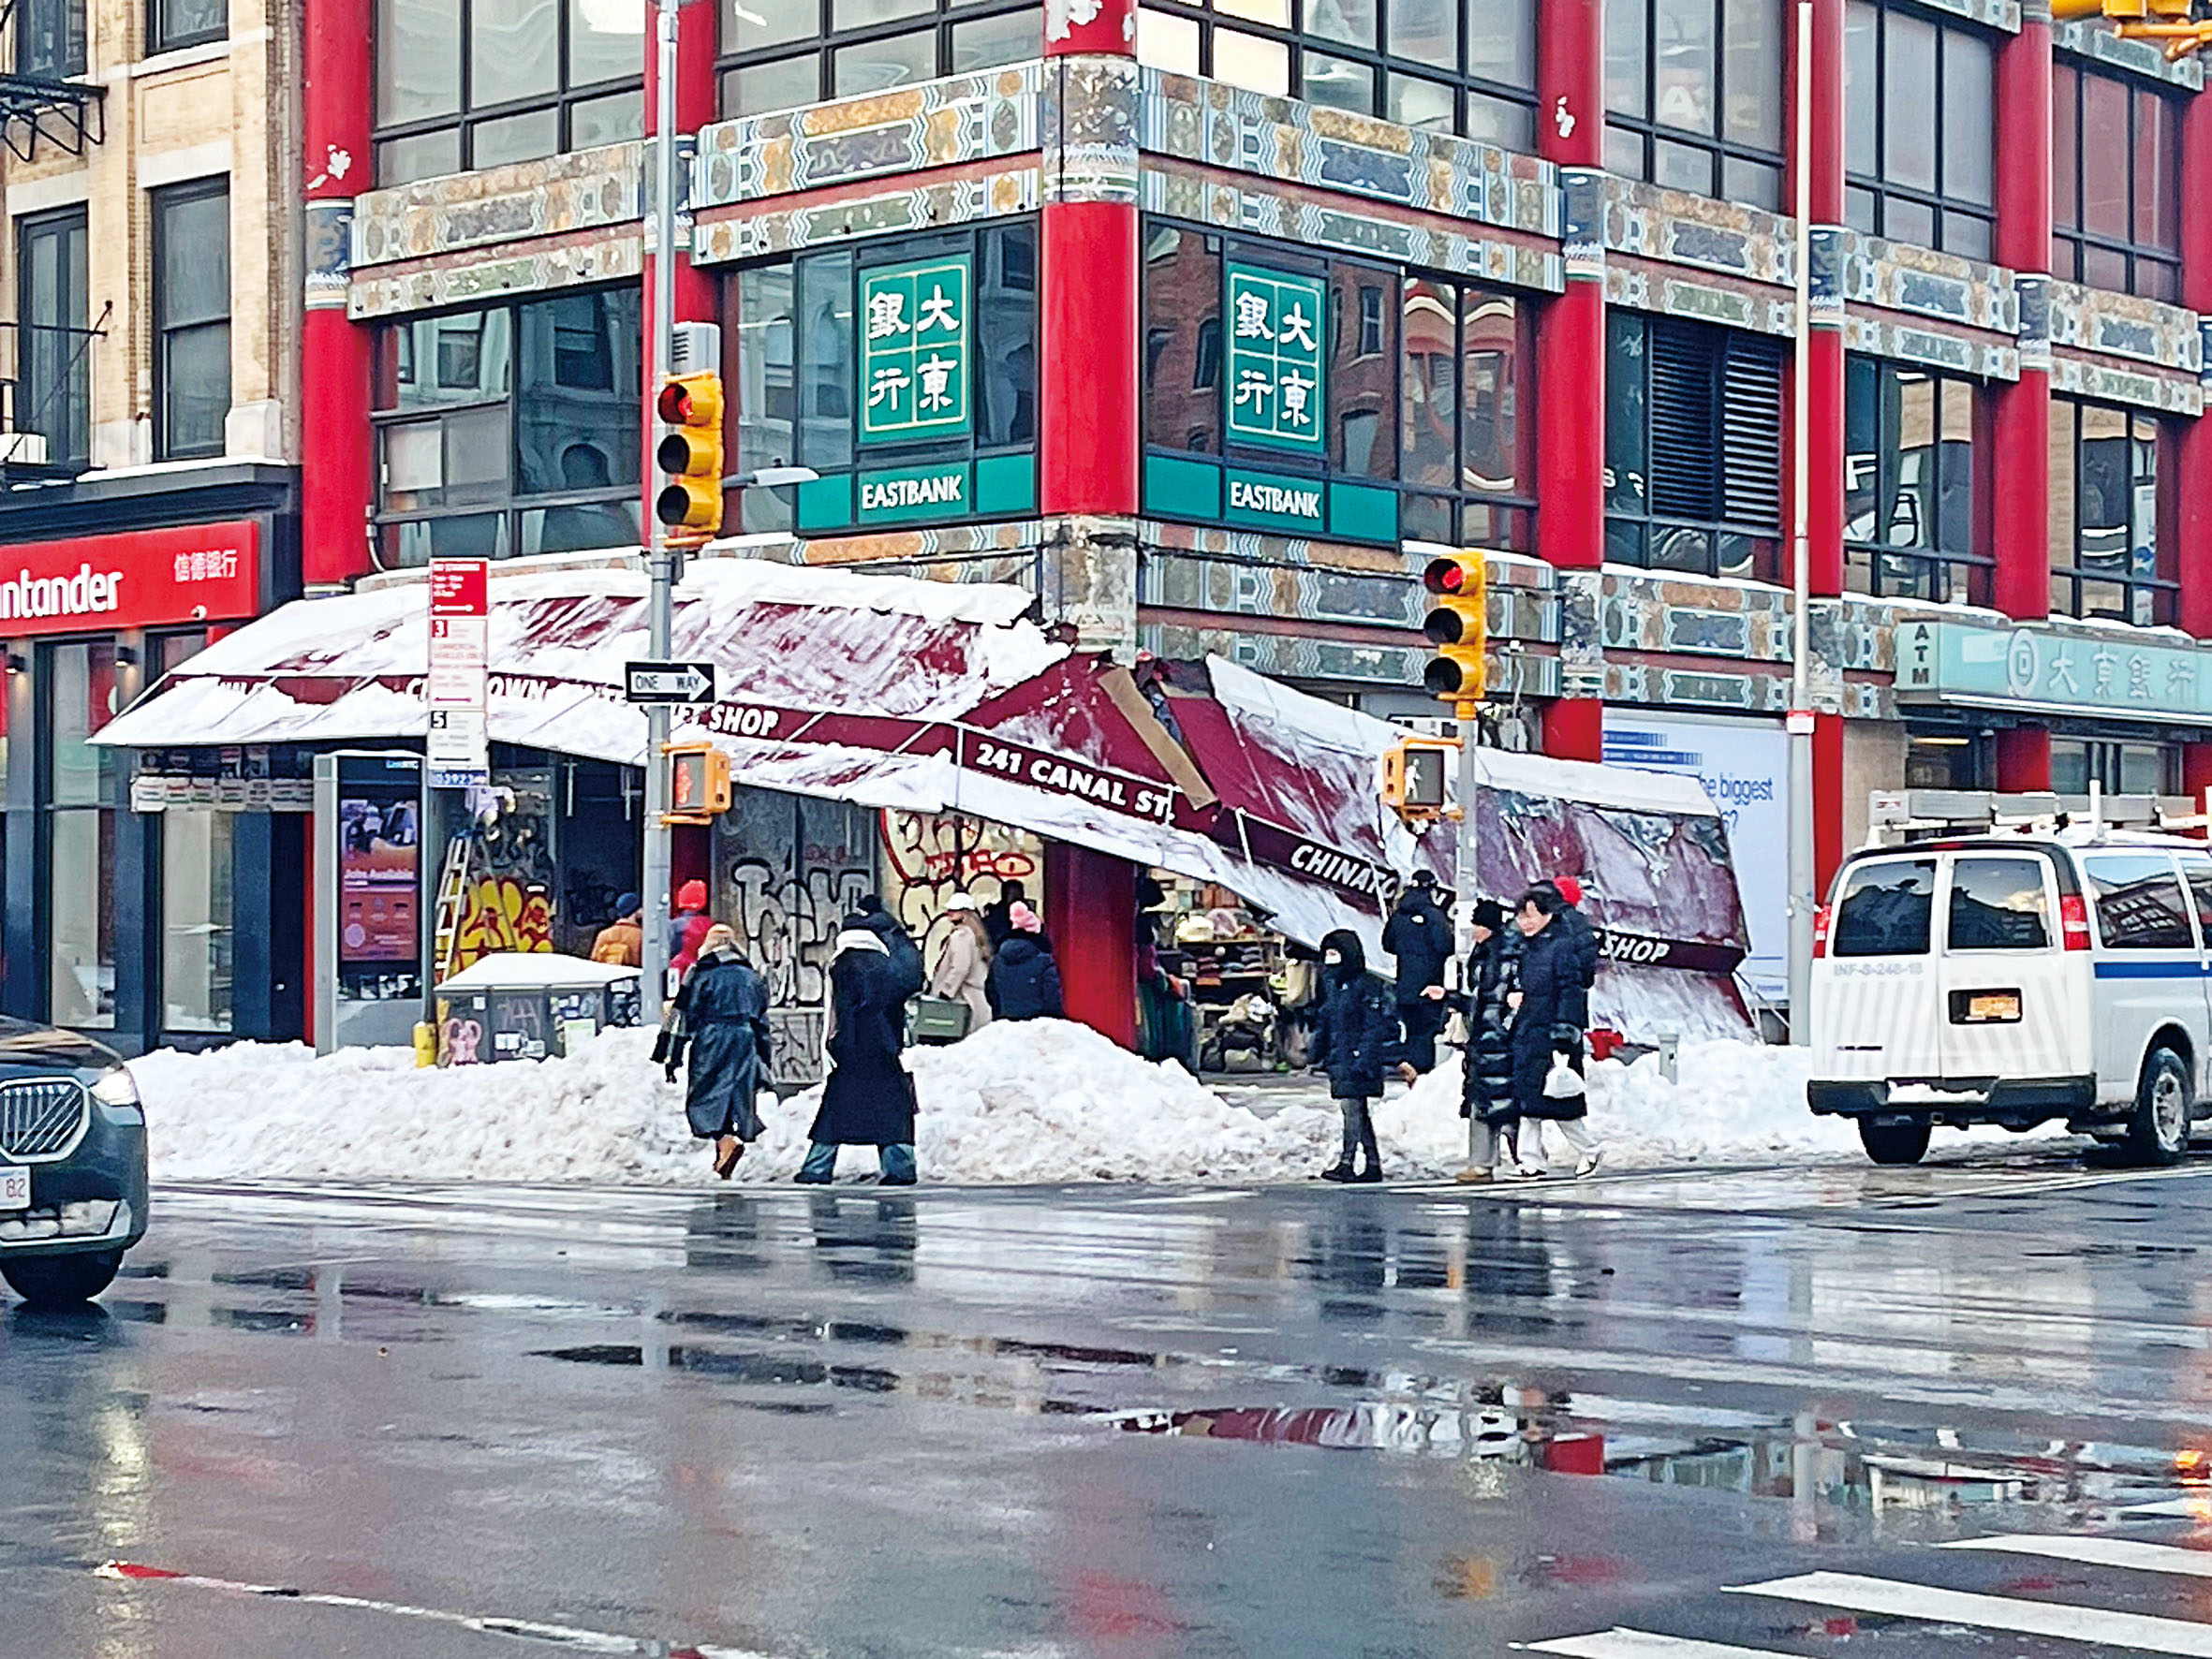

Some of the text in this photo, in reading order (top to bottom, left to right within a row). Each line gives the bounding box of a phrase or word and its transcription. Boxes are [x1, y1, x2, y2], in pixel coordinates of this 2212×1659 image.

[862, 475, 962, 510] EASTBANK
[1231, 481, 1320, 518] EASTBANK
[435, 620, 445, 638] 3
[1912, 624, 1929, 684] ATM
[635, 675, 700, 691] ONE WAY
[433, 712, 445, 727] 5
[708, 703, 779, 736] SHOP
[976, 743, 1023, 774] 241
[1030, 759, 1127, 806] CANAL
[1720, 772, 1774, 806] biggest
[1598, 934, 1670, 963] SHOP
